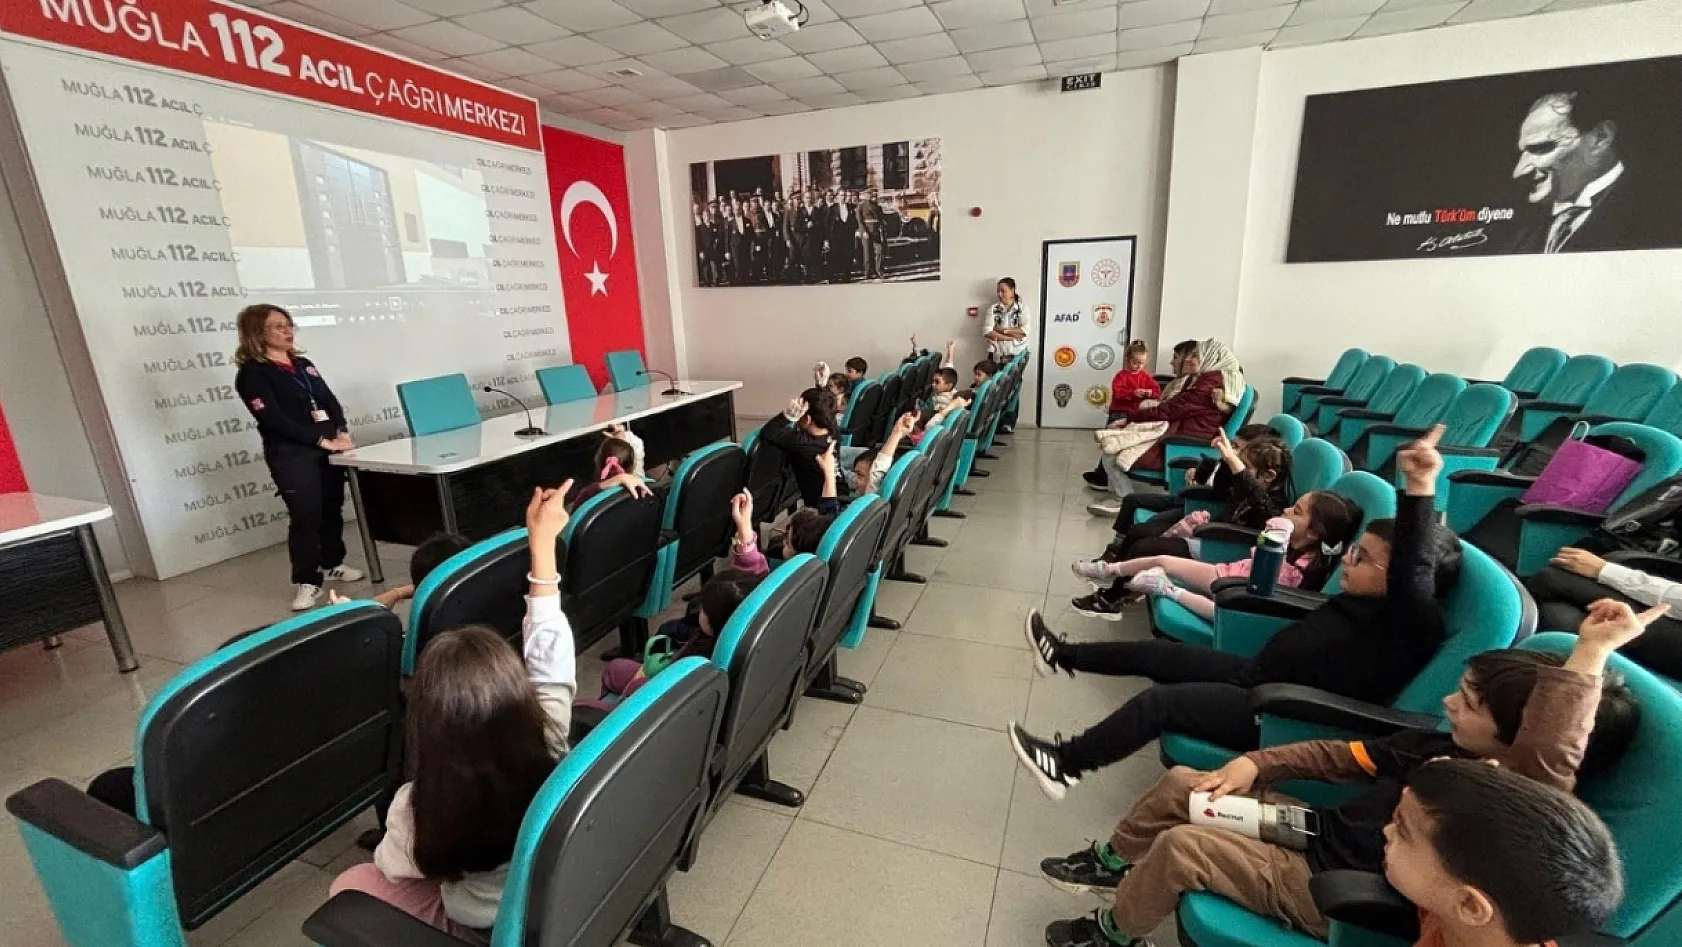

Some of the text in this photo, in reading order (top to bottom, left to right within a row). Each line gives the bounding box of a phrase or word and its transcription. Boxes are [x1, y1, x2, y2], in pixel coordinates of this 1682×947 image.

[208, 13, 291, 76] 112
[61, 79, 123, 101] MUĞLA
[123, 84, 158, 107] 112
[74, 122, 135, 143] MUĞLA
[134, 126, 168, 147] 112
[87, 166, 145, 183] MUĞLA
[145, 167, 178, 186] 112
[99, 206, 157, 221] MUĞLA
[157, 206, 189, 225] 112
[1386, 212, 1401, 226] Ne
[1403, 210, 1432, 225] mutlu
[1477, 207, 1514, 224] diyene
[111, 246, 168, 262] MUĞLA
[168, 244, 199, 262] 112
[122, 284, 178, 299] MUĞLA
[178, 281, 209, 298] 112
[133, 321, 186, 337] MUĞLA
[187, 317, 217, 333] 112
[1054, 312, 1080, 323] AFAD
[143, 358, 197, 374] MUĞLA
[196, 352, 227, 368] 112
[154, 385, 235, 410] MUĞLA 112
[382, 407, 401, 421] 112
[165, 427, 216, 445] MUĞLA
[215, 418, 243, 435] 112
[173, 460, 224, 479] MUĞLA
[224, 450, 251, 468] 112
[184, 492, 232, 512] MUĞLA
[232, 482, 260, 499] 112
[194, 523, 242, 545] MUĞLA
[241, 511, 268, 530] 112
